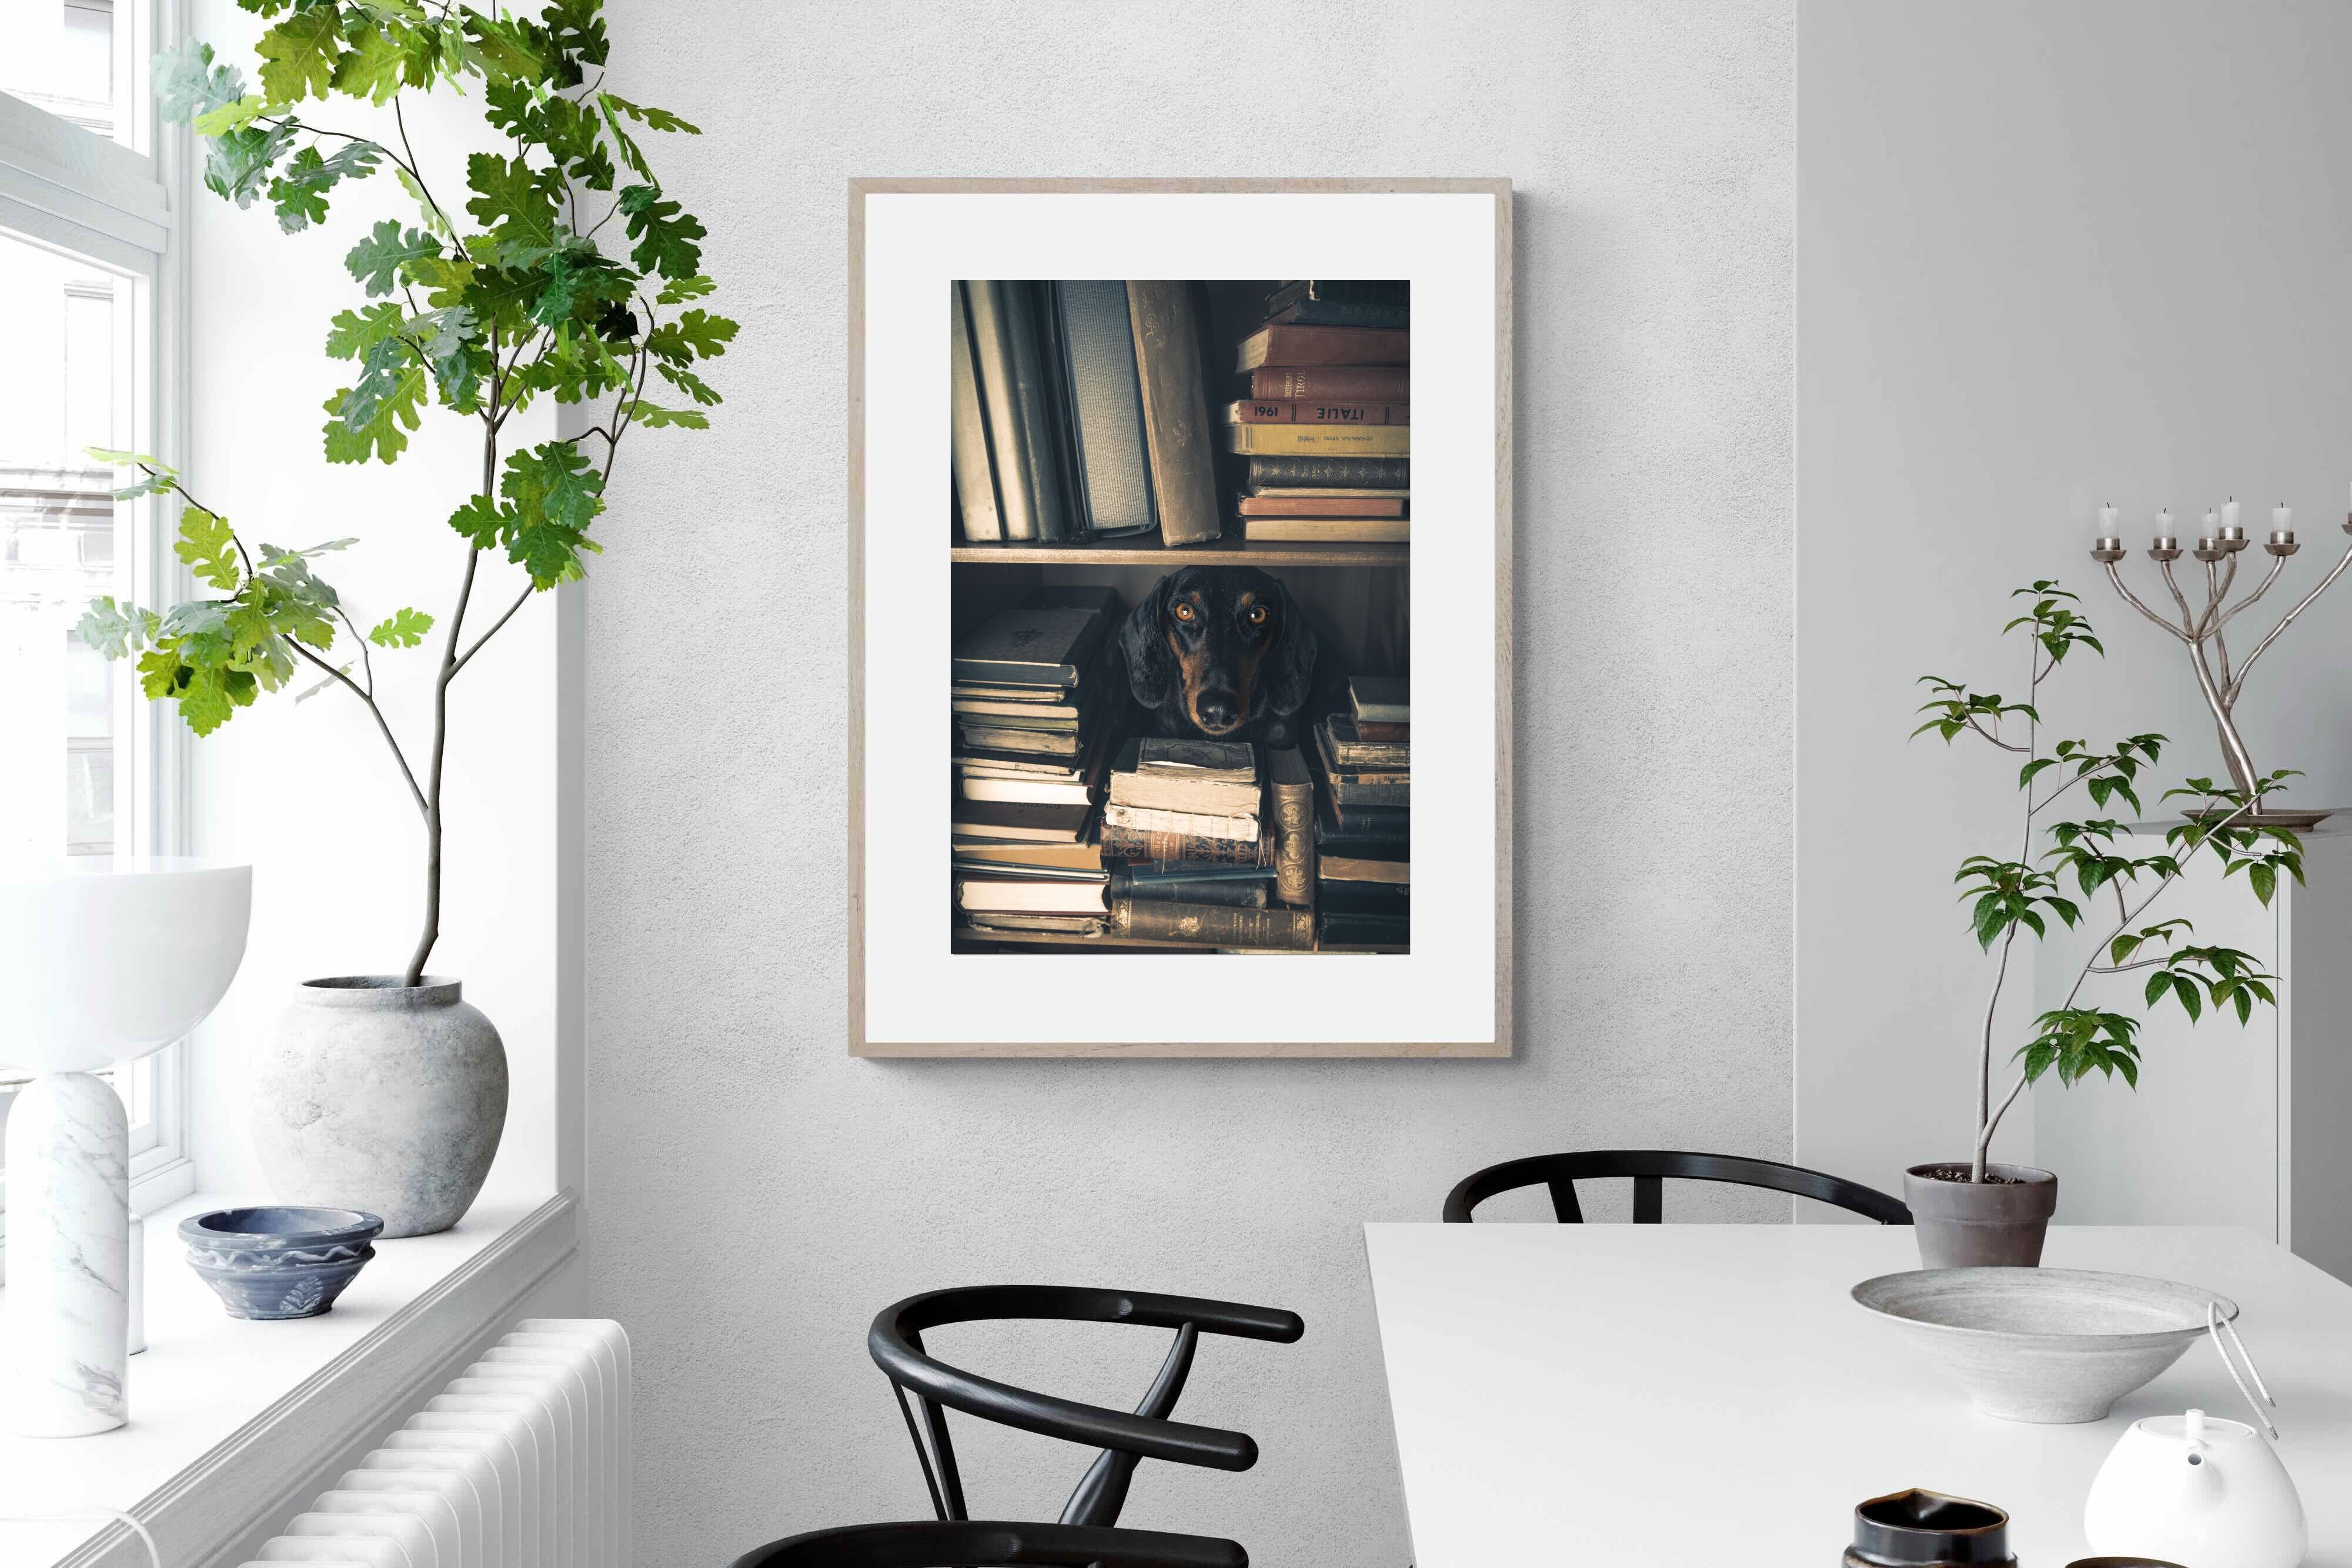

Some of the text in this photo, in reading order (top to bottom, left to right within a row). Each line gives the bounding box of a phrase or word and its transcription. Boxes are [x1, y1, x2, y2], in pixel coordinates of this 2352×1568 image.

[1284, 372, 1292, 397] BAEDEKERS
[1294, 369, 1308, 400] TIROL
[1254, 406, 1364, 420] ITALIE 1961
